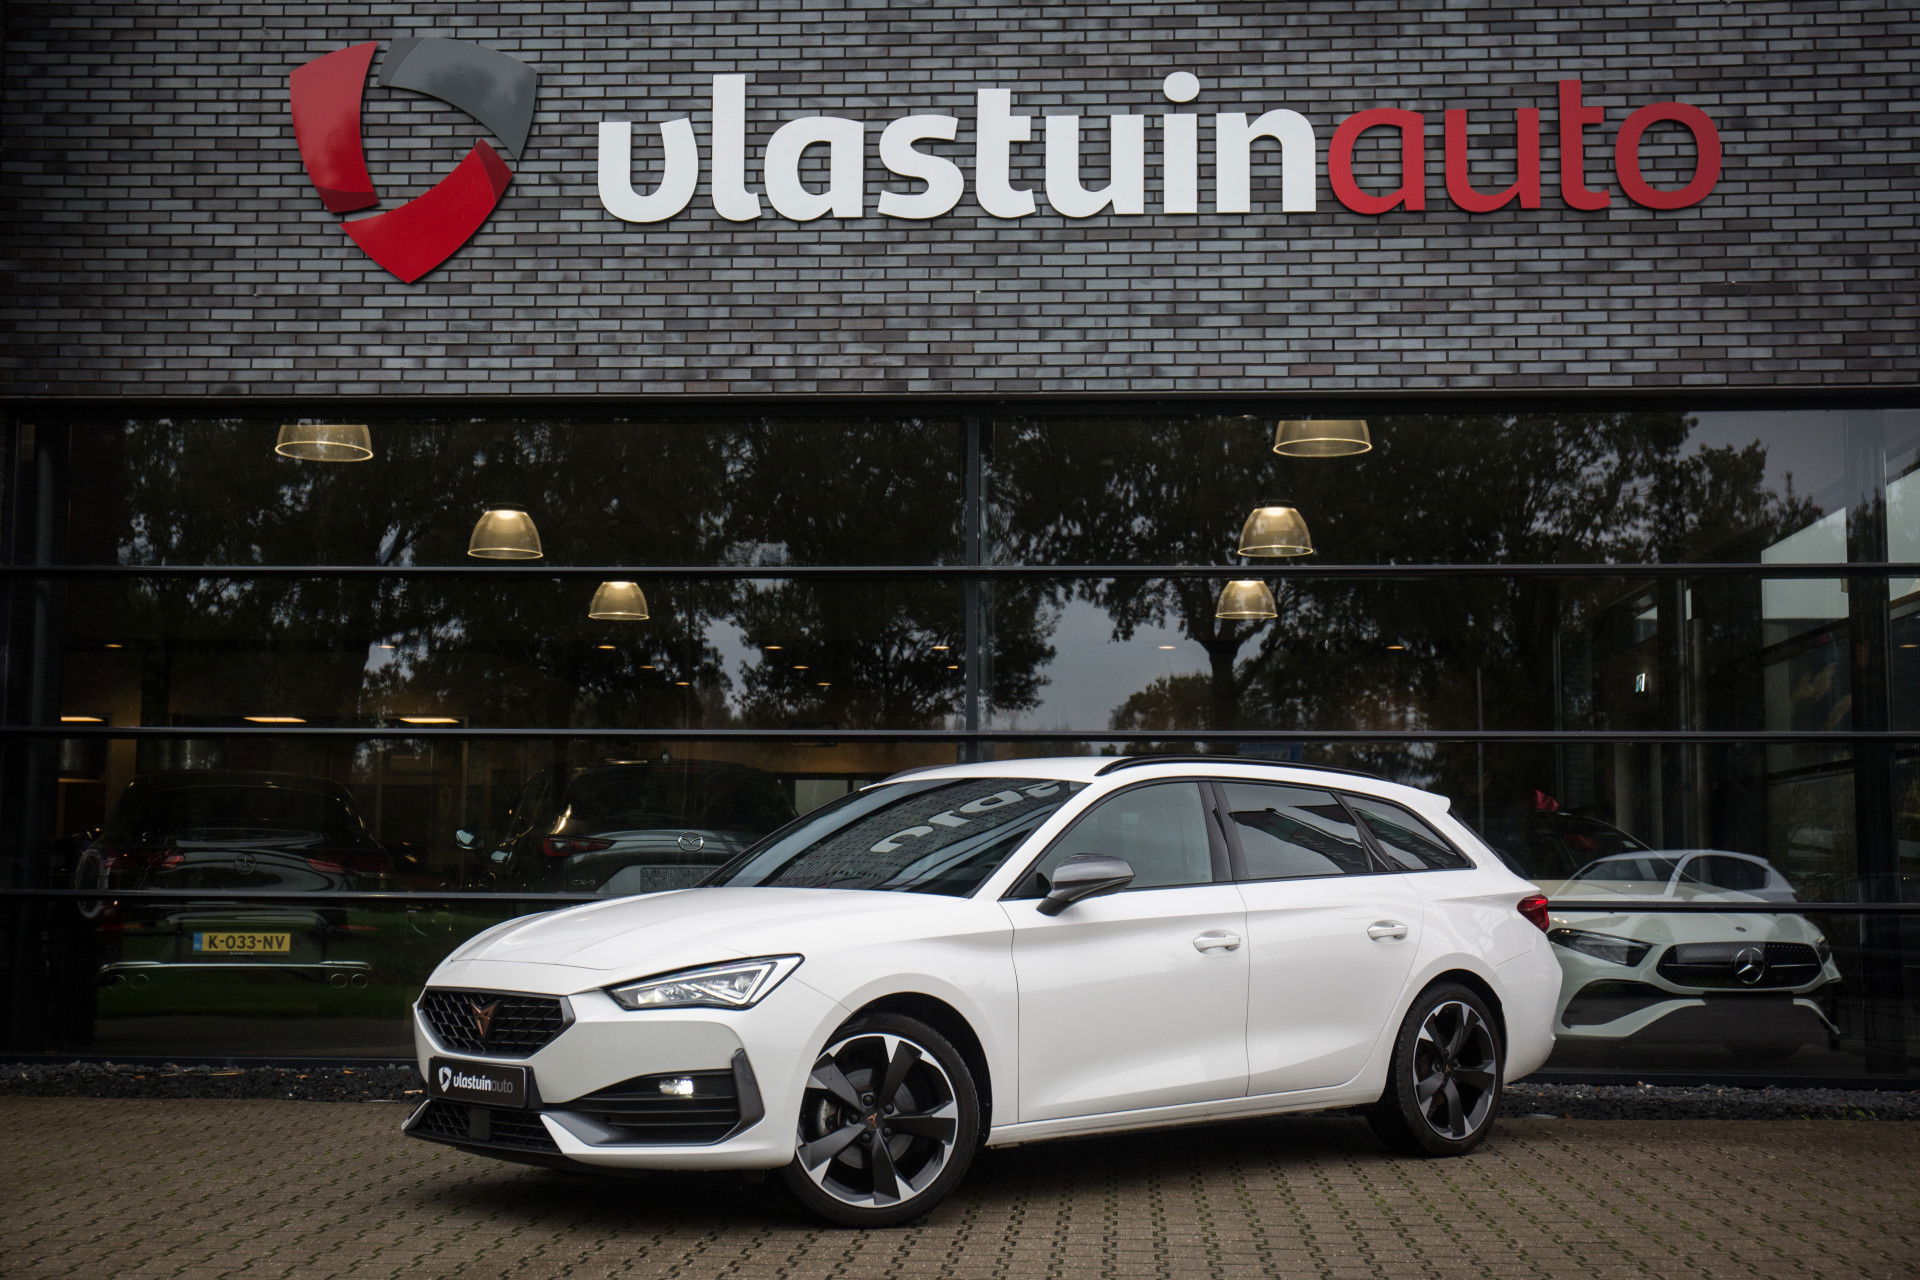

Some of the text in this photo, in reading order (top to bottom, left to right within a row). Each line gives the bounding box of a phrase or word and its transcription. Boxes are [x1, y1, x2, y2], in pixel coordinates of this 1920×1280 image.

[598, 72, 1722, 222] vlastuinauto
[208, 935, 285, 949] K-033-NV
[453, 1072, 513, 1093] vlastuinauto
